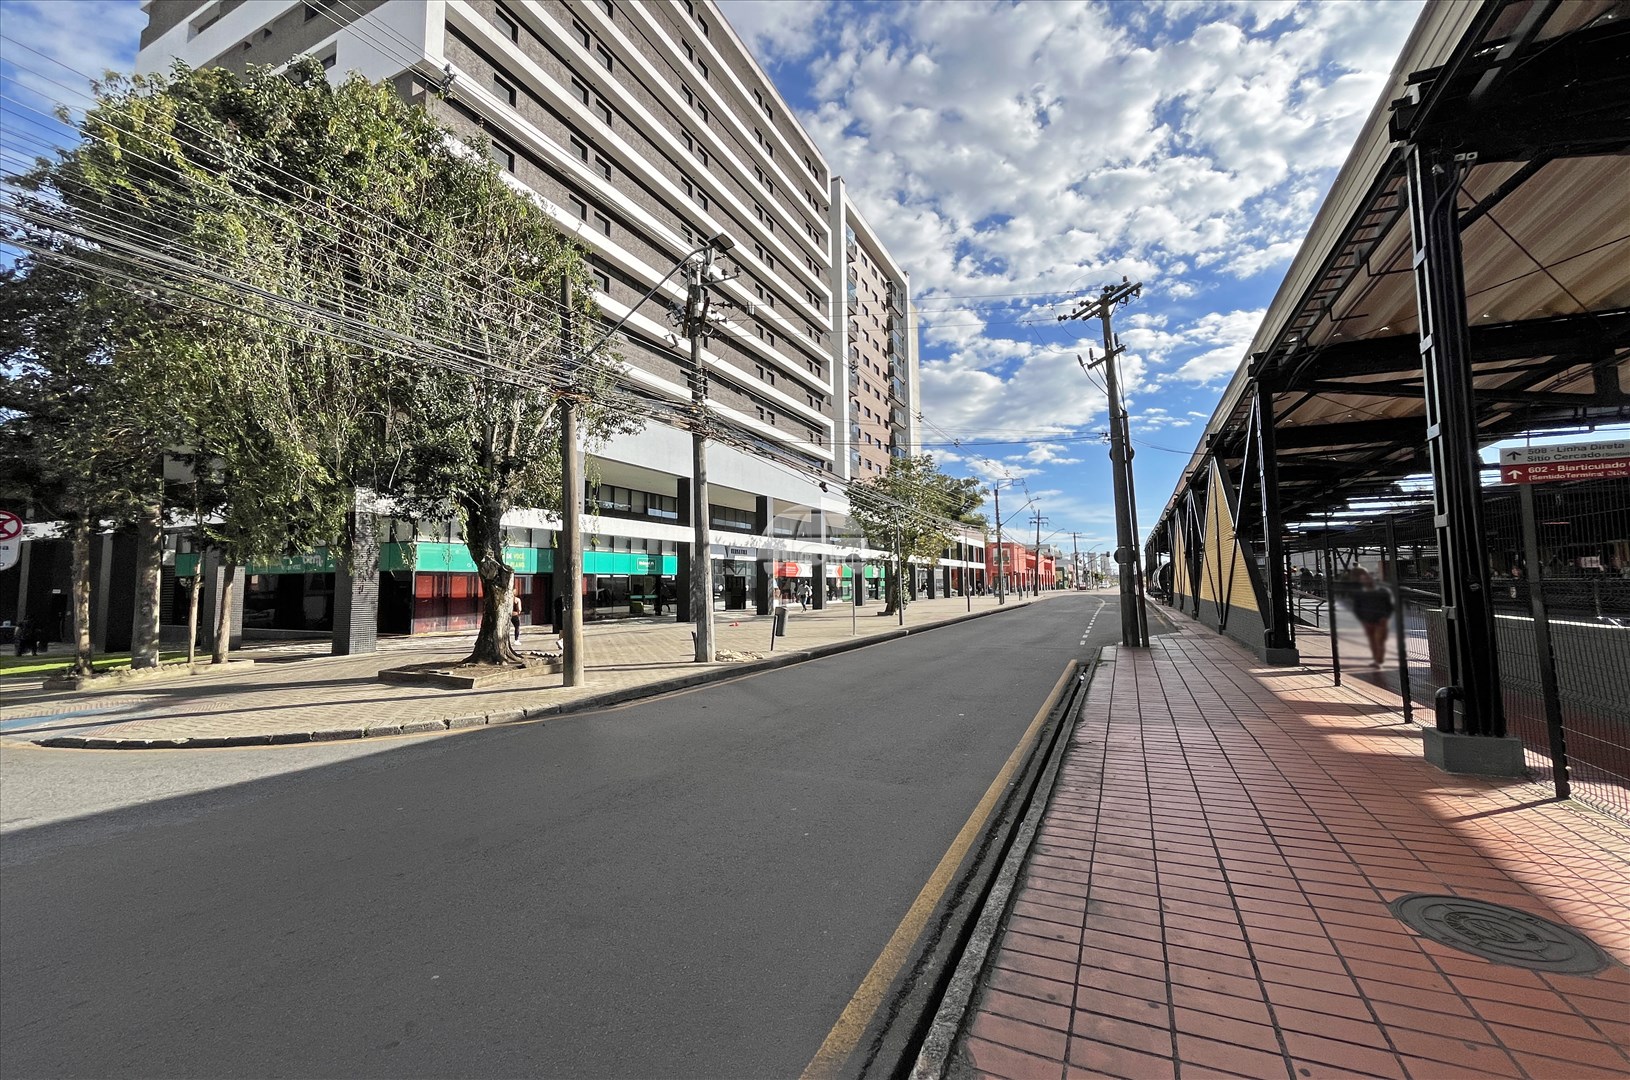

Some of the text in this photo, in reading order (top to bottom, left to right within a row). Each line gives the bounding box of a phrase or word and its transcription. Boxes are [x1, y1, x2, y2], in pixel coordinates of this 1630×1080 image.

[1556, 445, 1587, 453] Linha
[1590, 443, 1625, 451] Direta
[1553, 452, 1602, 461] Cercado
[1527, 466, 1548, 474] 602
[1557, 461, 1627, 472] Biarticulado
[1528, 473, 1566, 482] (Sentido
